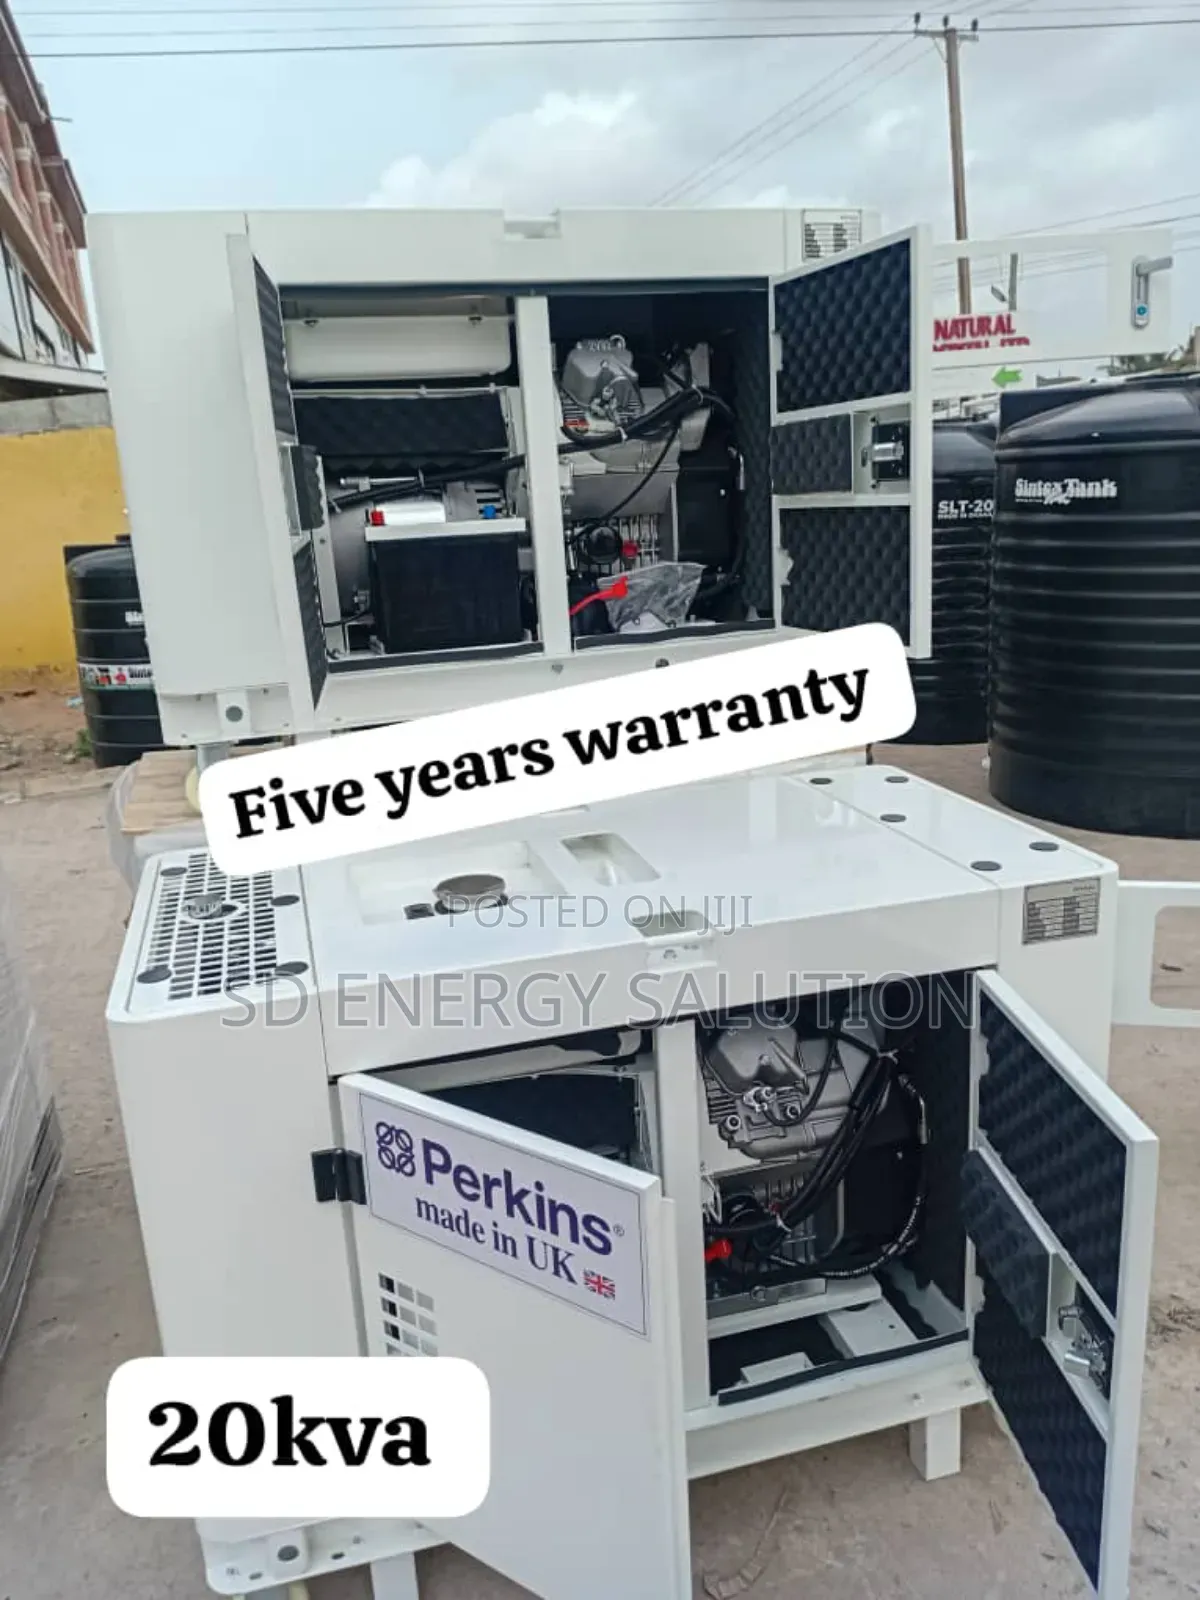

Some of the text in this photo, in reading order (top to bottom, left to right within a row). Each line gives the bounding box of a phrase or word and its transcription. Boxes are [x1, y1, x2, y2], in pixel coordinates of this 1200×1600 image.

[934, 314, 1016, 340] NATURAL
[415, 1197, 578, 1285] made in UK
[421, 1138, 613, 1256] Perkins
